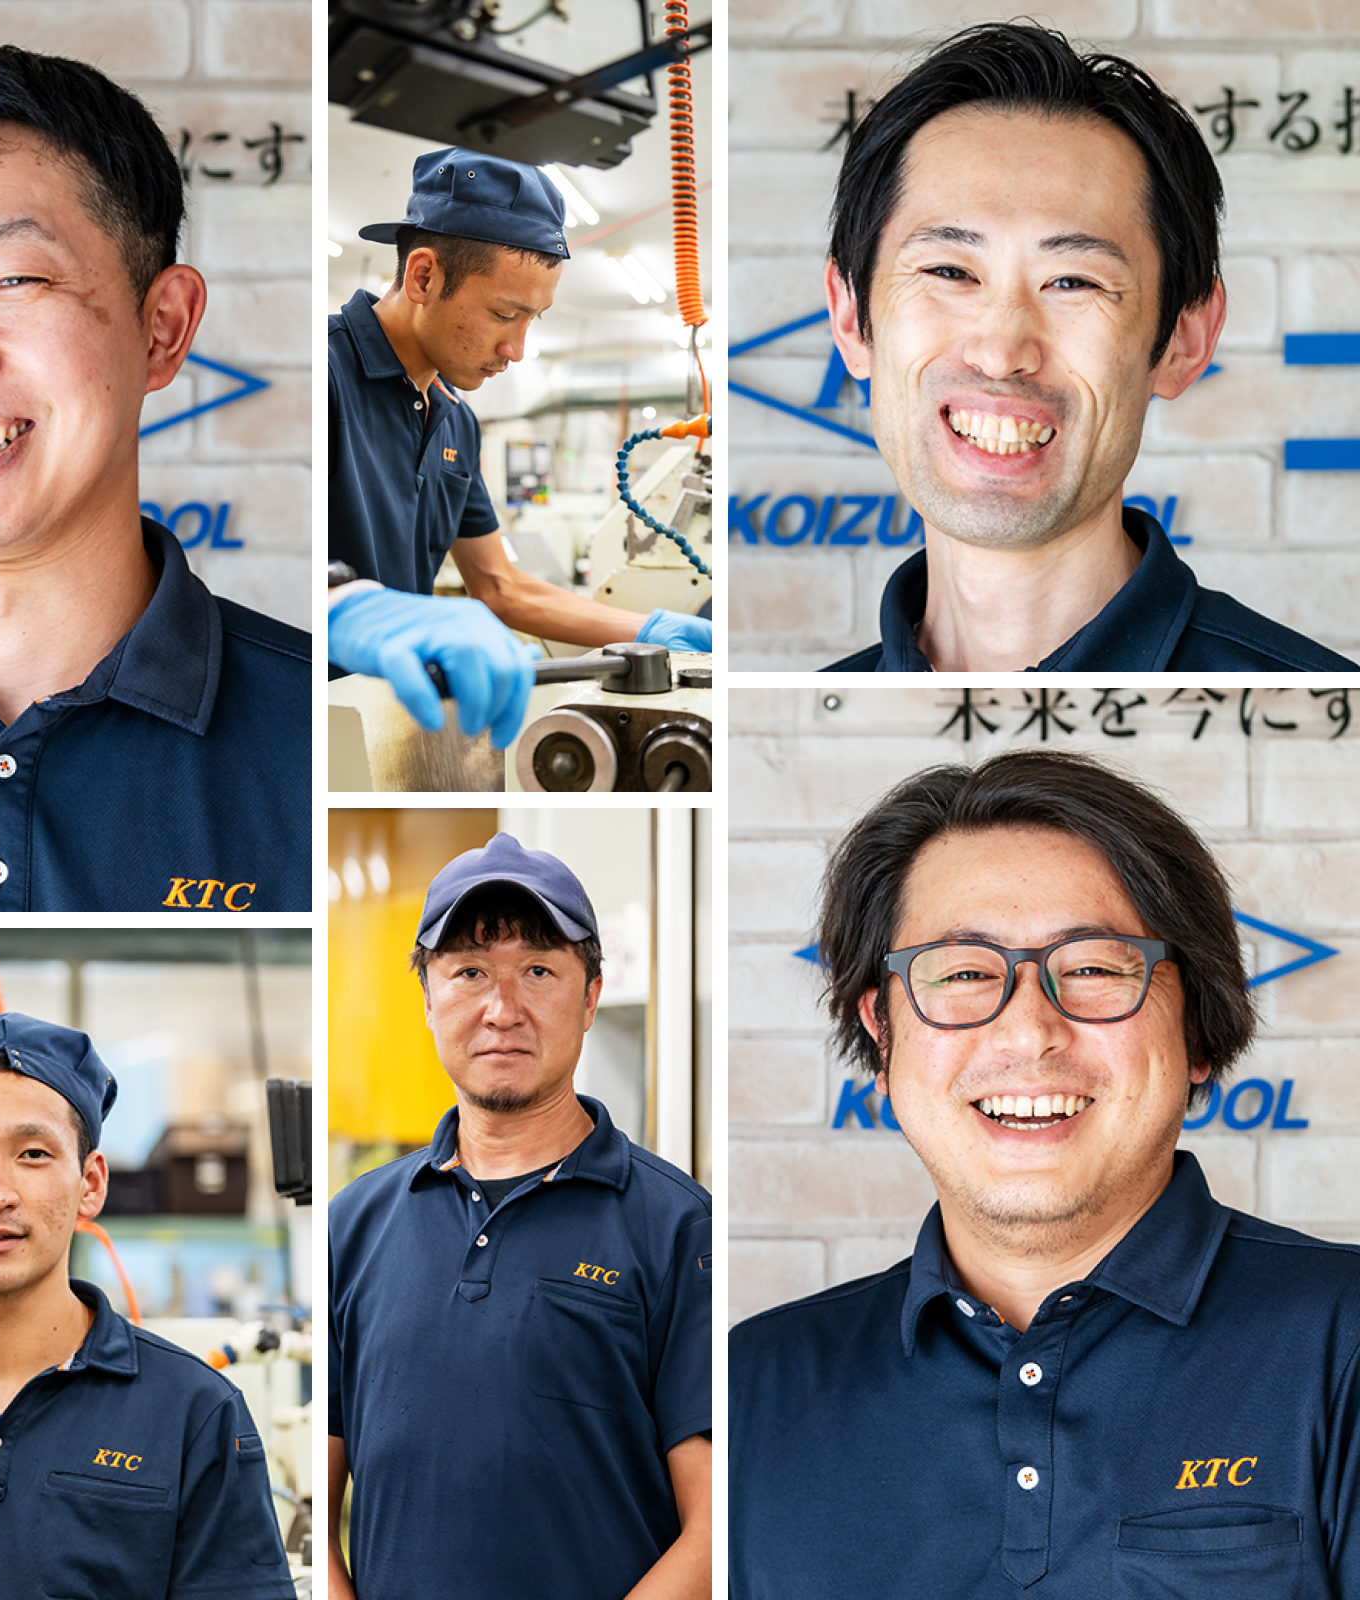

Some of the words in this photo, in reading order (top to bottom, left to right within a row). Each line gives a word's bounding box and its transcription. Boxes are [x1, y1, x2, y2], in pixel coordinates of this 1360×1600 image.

[728, 493, 927, 547] KOIZU
[161, 877, 256, 911] KTC
[573, 1261, 620, 1285] KTC
[92, 1447, 143, 1471] KTC
[1174, 1456, 1258, 1489] KTC
